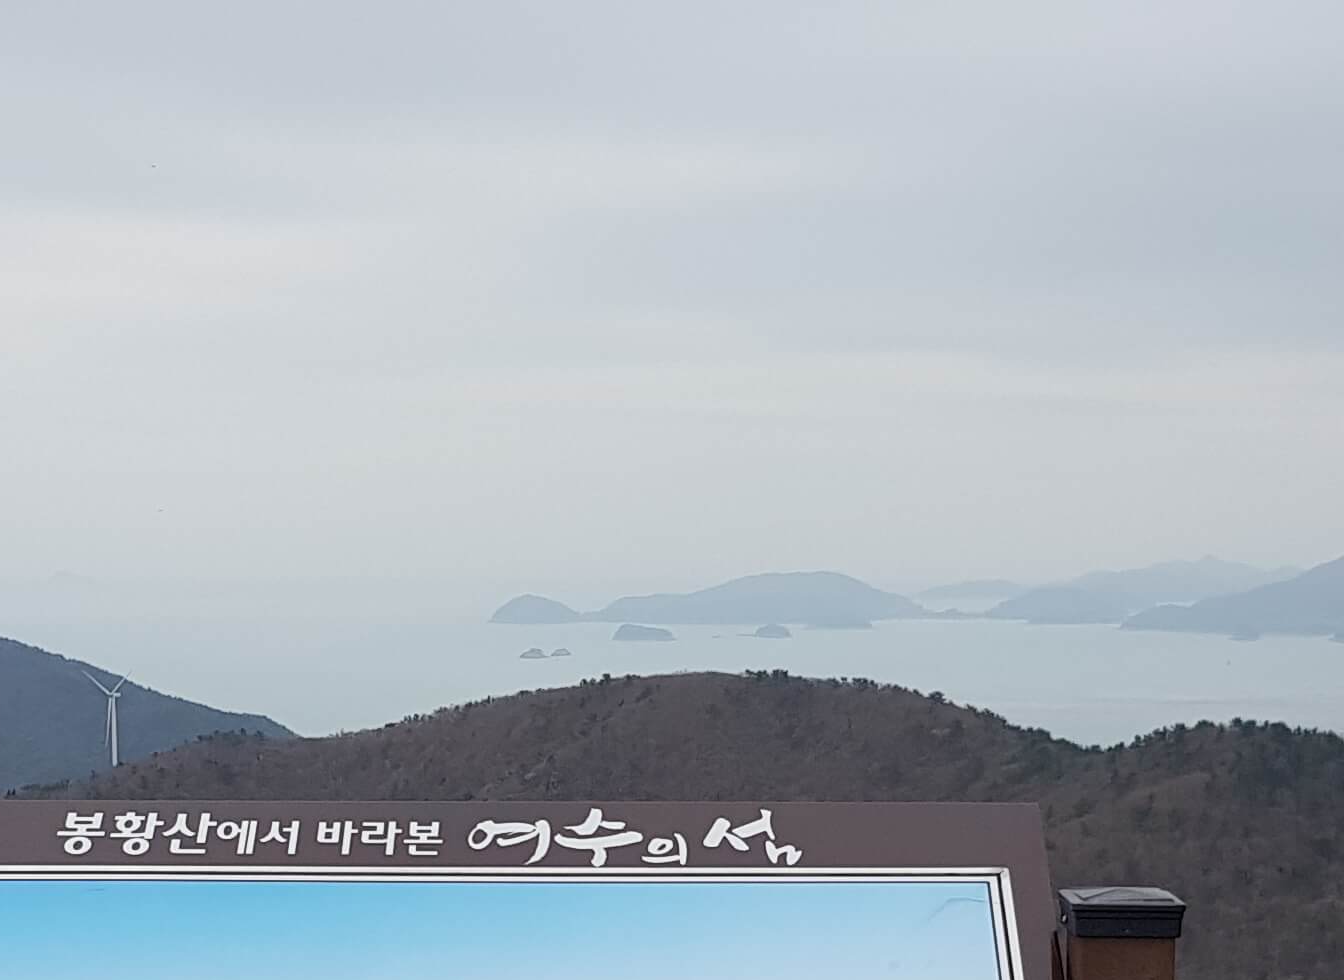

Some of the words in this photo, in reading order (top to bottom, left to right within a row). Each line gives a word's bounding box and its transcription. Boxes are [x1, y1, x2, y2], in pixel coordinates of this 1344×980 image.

[57, 811, 300, 857] 봉황산에서
[317, 819, 444, 857] 바라본
[468, 807, 688, 868] 여수의
[703, 808, 802, 866] 섬
